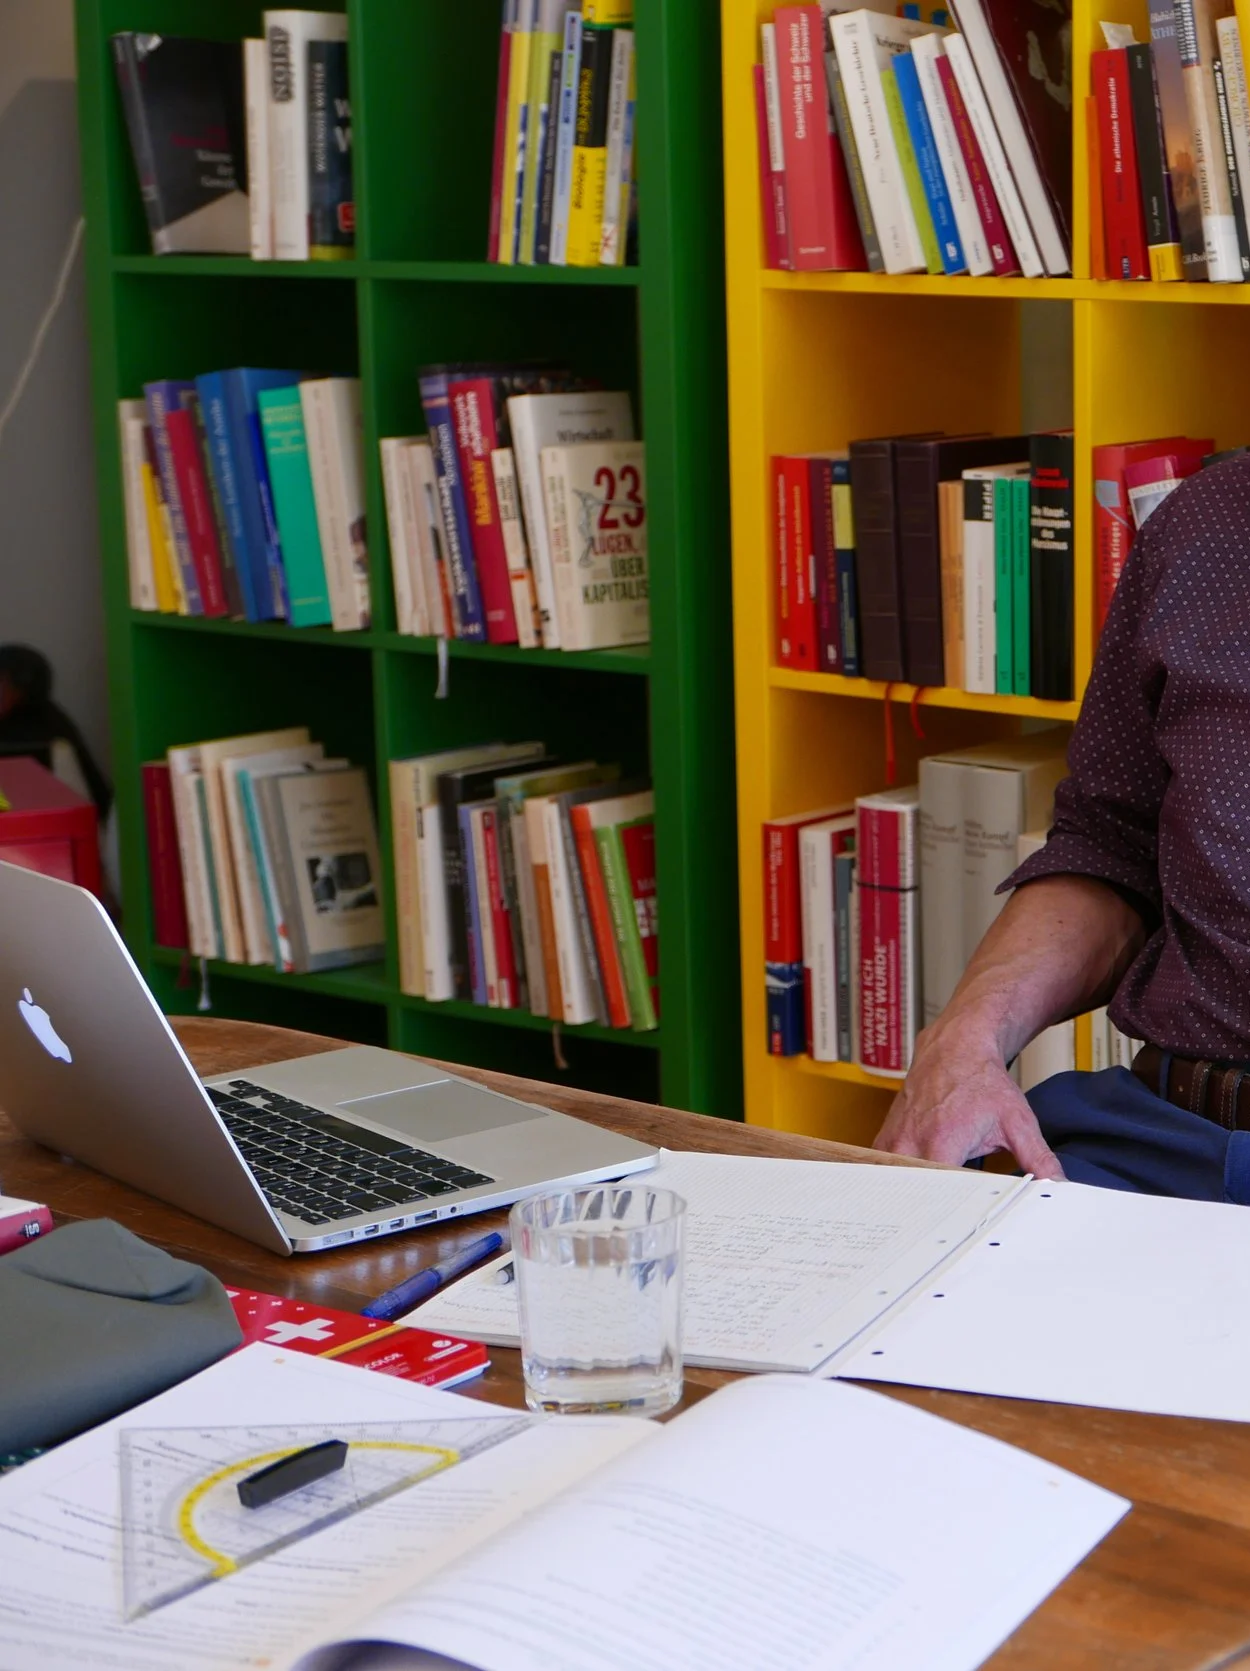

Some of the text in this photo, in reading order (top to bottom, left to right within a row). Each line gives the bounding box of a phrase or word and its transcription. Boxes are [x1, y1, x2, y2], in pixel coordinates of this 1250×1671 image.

[798, 12, 810, 63] Schweizer
[789, 22, 806, 139] Geschichte Schweiz
[1107, 77, 1119, 119] Demokratie
[594, 464, 645, 529] 23
[982, 482, 993, 519] PIPER
[1111, 522, 1120, 558] Krieges
[863, 959, 874, 985] ICH
[875, 1008, 887, 1046] NAZI
